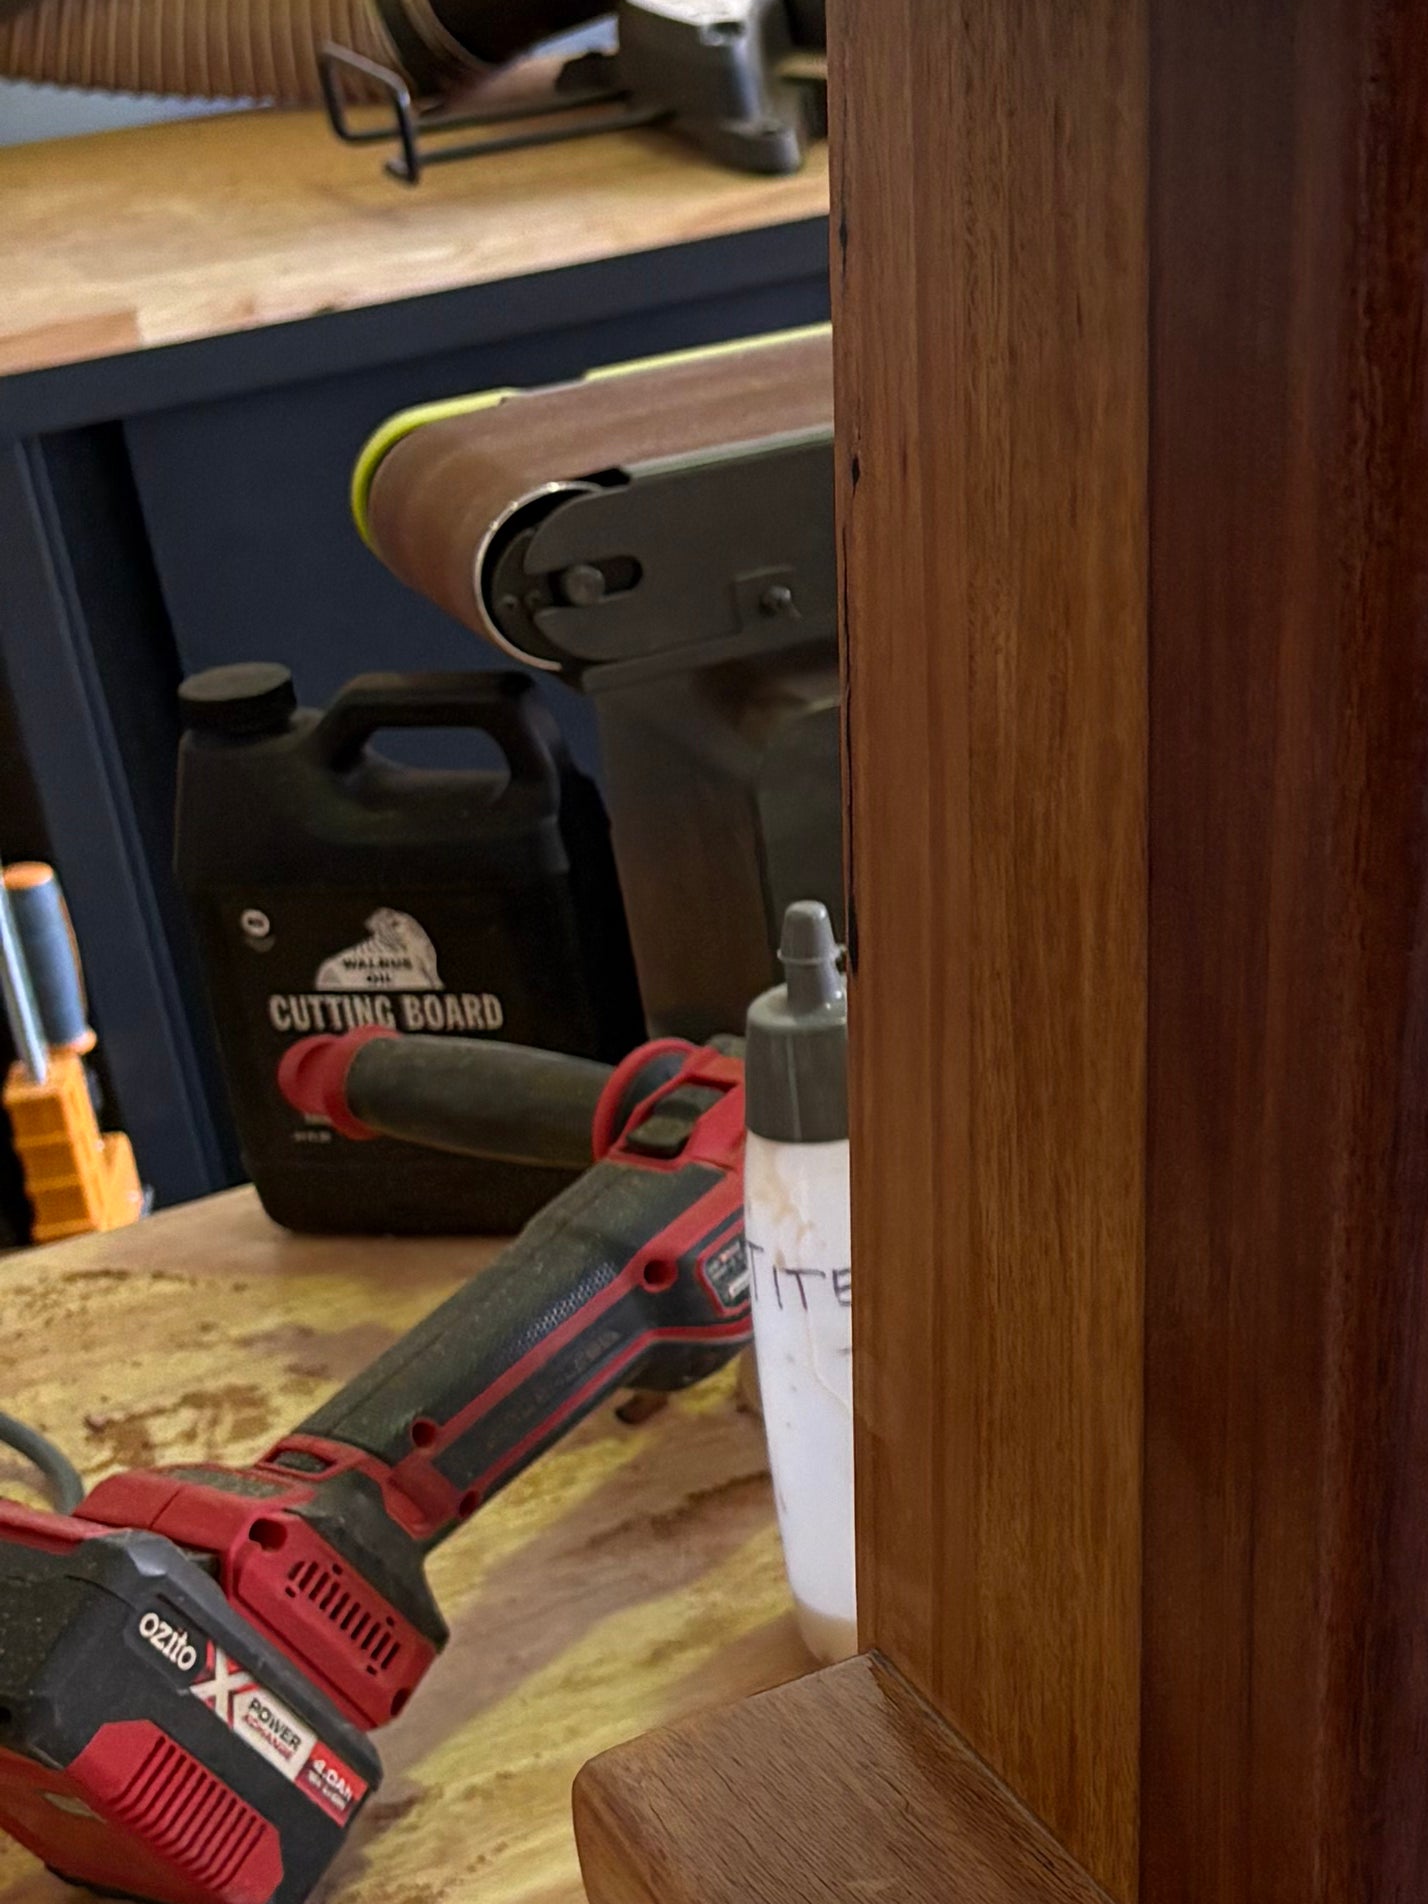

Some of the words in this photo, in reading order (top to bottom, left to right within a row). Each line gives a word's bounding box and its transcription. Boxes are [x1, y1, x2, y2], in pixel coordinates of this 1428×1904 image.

[268, 994, 397, 1032] CUTTING
[402, 993, 504, 1032] BOARD
[138, 1612, 198, 1671] ozito
[248, 1698, 303, 1753] POWER
